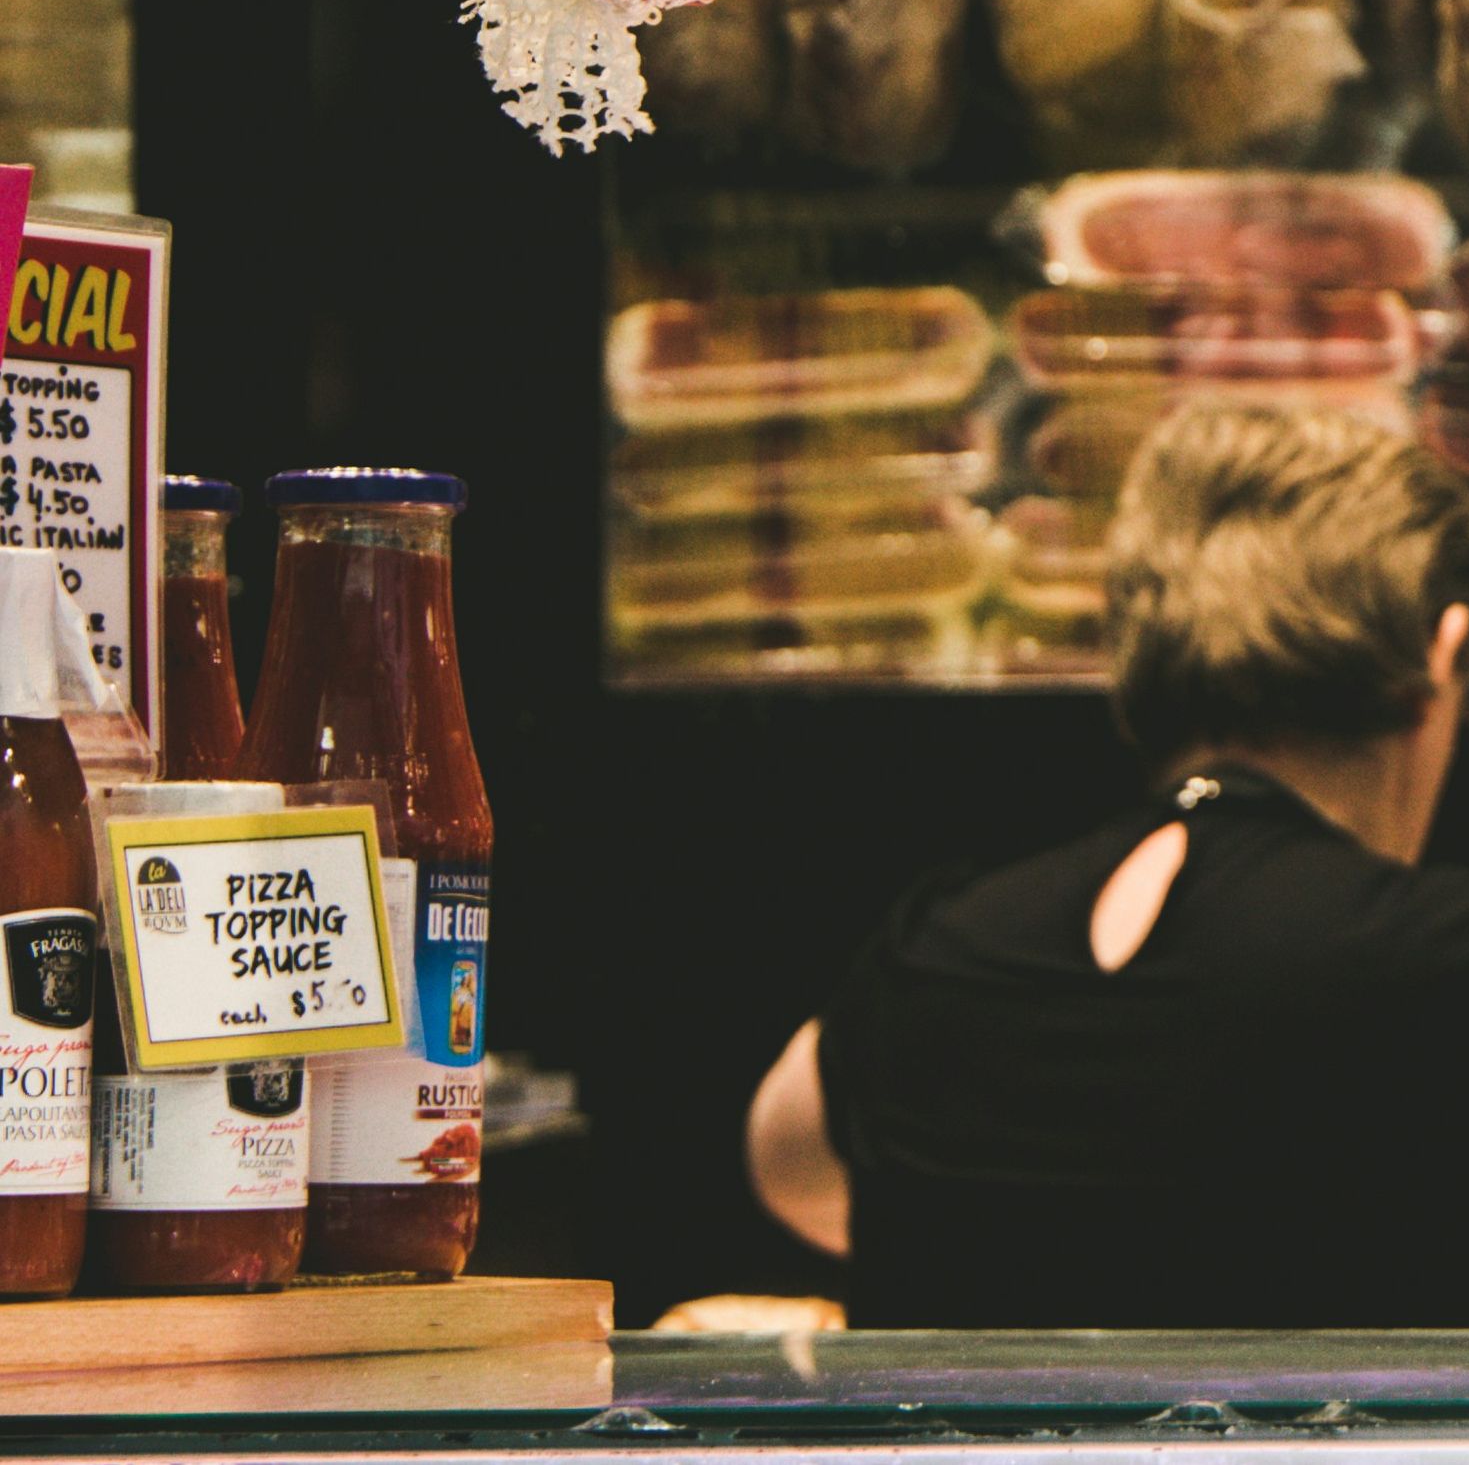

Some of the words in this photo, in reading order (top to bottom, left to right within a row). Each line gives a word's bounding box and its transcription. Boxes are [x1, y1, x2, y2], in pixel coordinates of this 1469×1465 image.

[31, 456, 102, 484] PASTA
[205, 905, 348, 945] TOPPING
[231, 941, 333, 978] SAUCE
[241, 1137, 295, 1156] PIZZA
